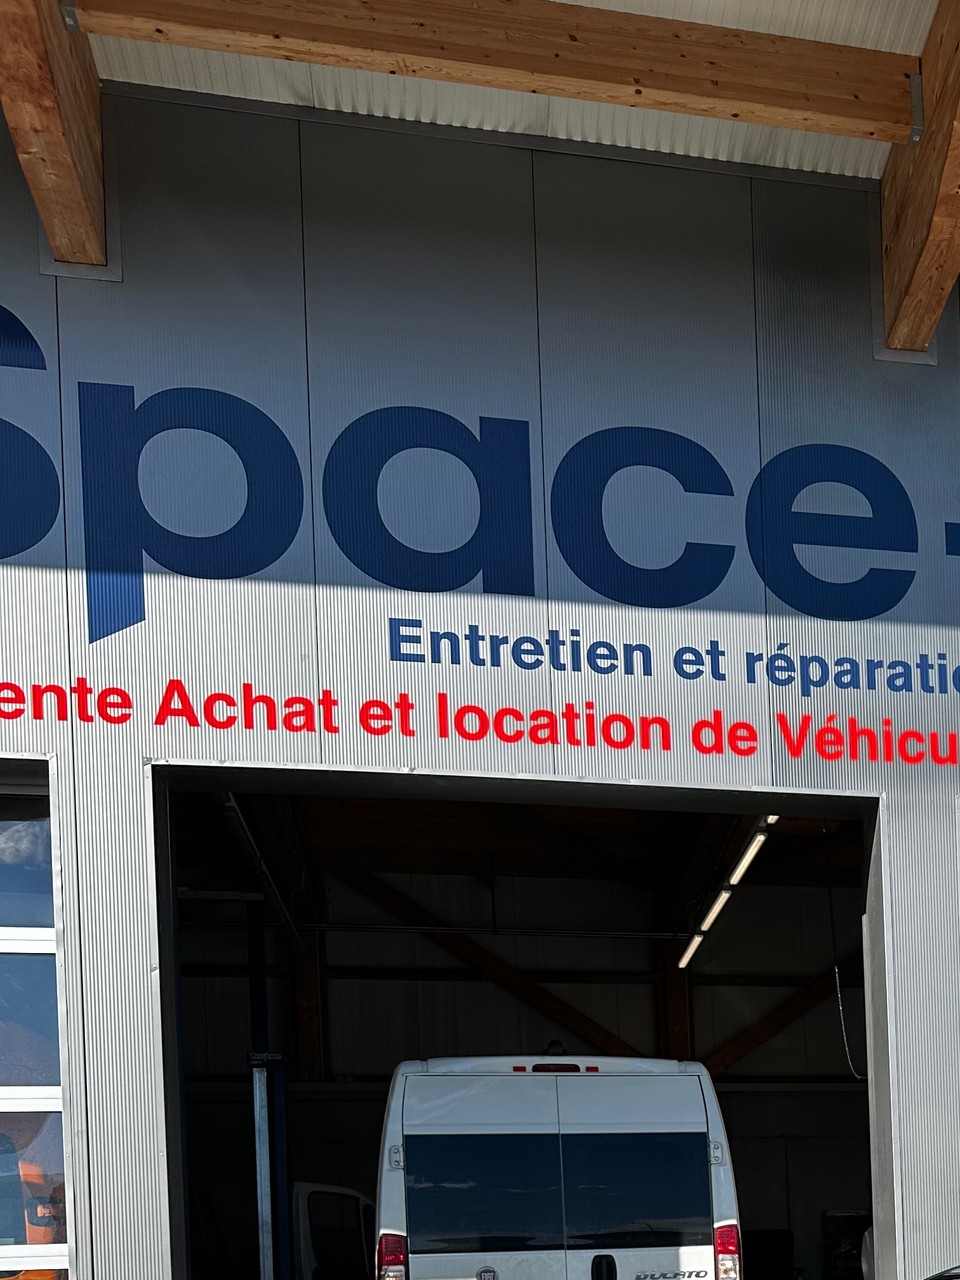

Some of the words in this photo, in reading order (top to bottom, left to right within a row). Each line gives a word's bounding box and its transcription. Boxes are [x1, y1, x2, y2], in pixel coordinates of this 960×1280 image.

[389, 617, 652, 676] Entretien
[674, 640, 726, 681] et
[154, 679, 340, 736] Achat
[358, 692, 416, 739] et
[437, 693, 673, 753] location
[691, 710, 758, 759] de
[635, 1269, 708, 1280] DUCATO
